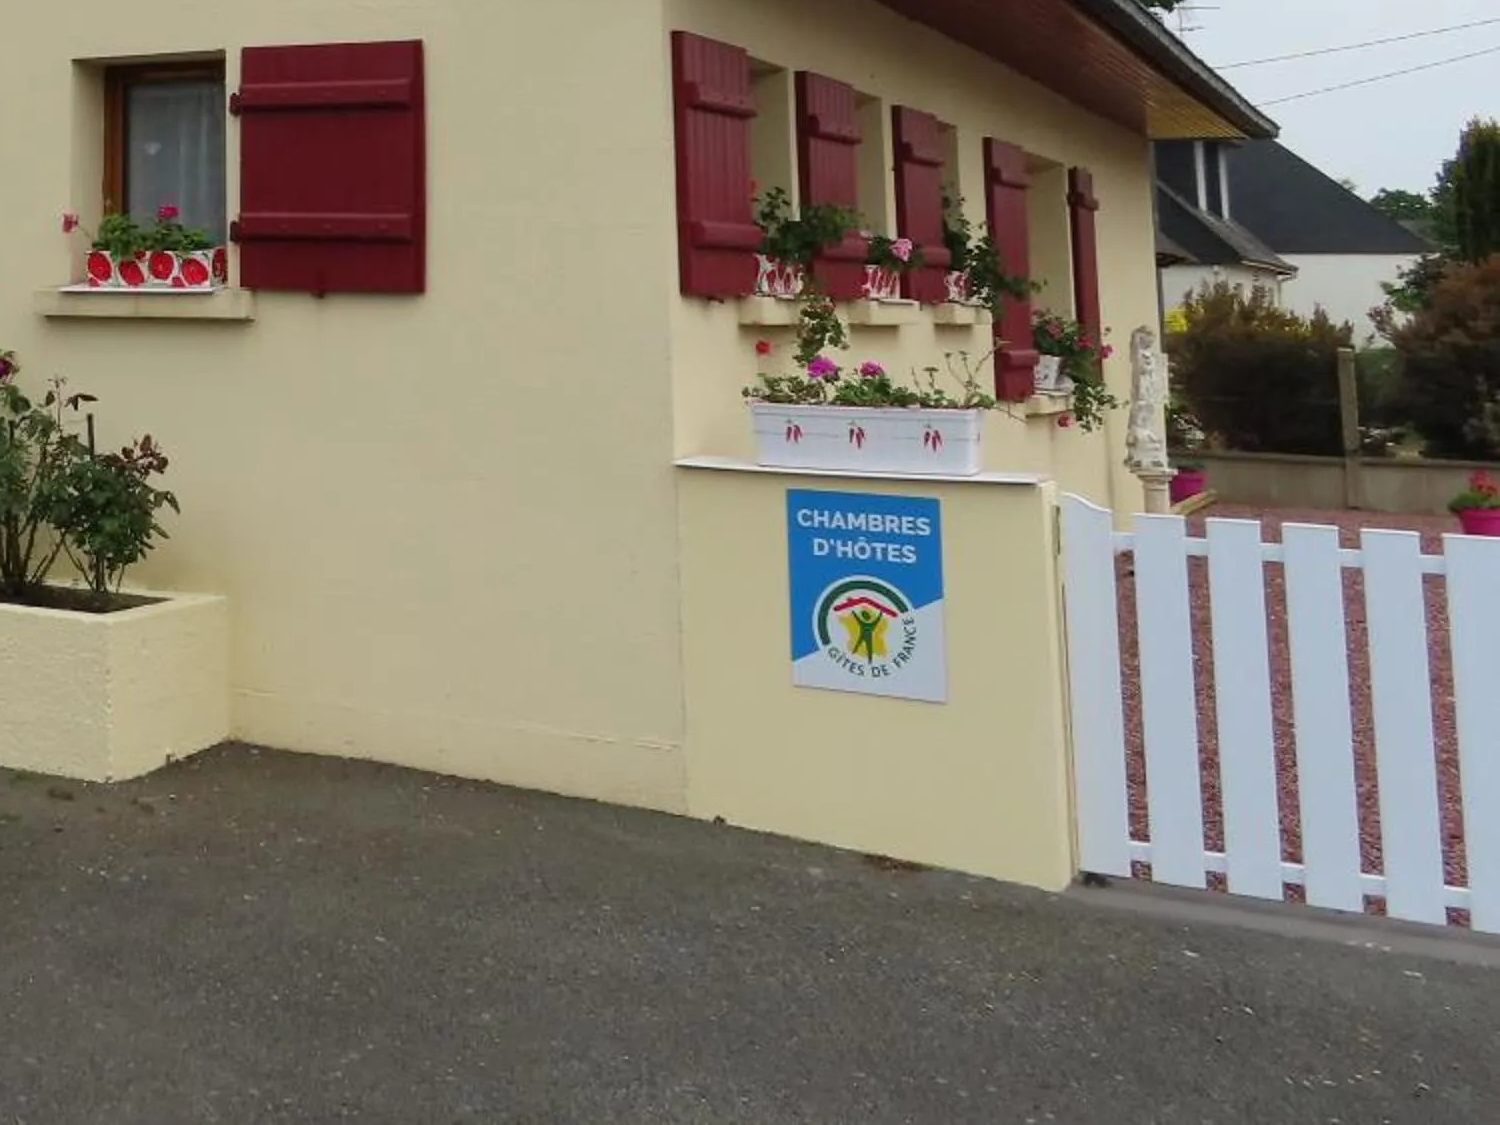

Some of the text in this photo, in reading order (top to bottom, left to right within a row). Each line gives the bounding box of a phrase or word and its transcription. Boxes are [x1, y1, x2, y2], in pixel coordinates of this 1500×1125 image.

[796, 508, 931, 536] CHAMBRES
[812, 536, 917, 564] D'HÔTES
[871, 664, 891, 678] DE
[892, 616, 917, 668] FRANCE
